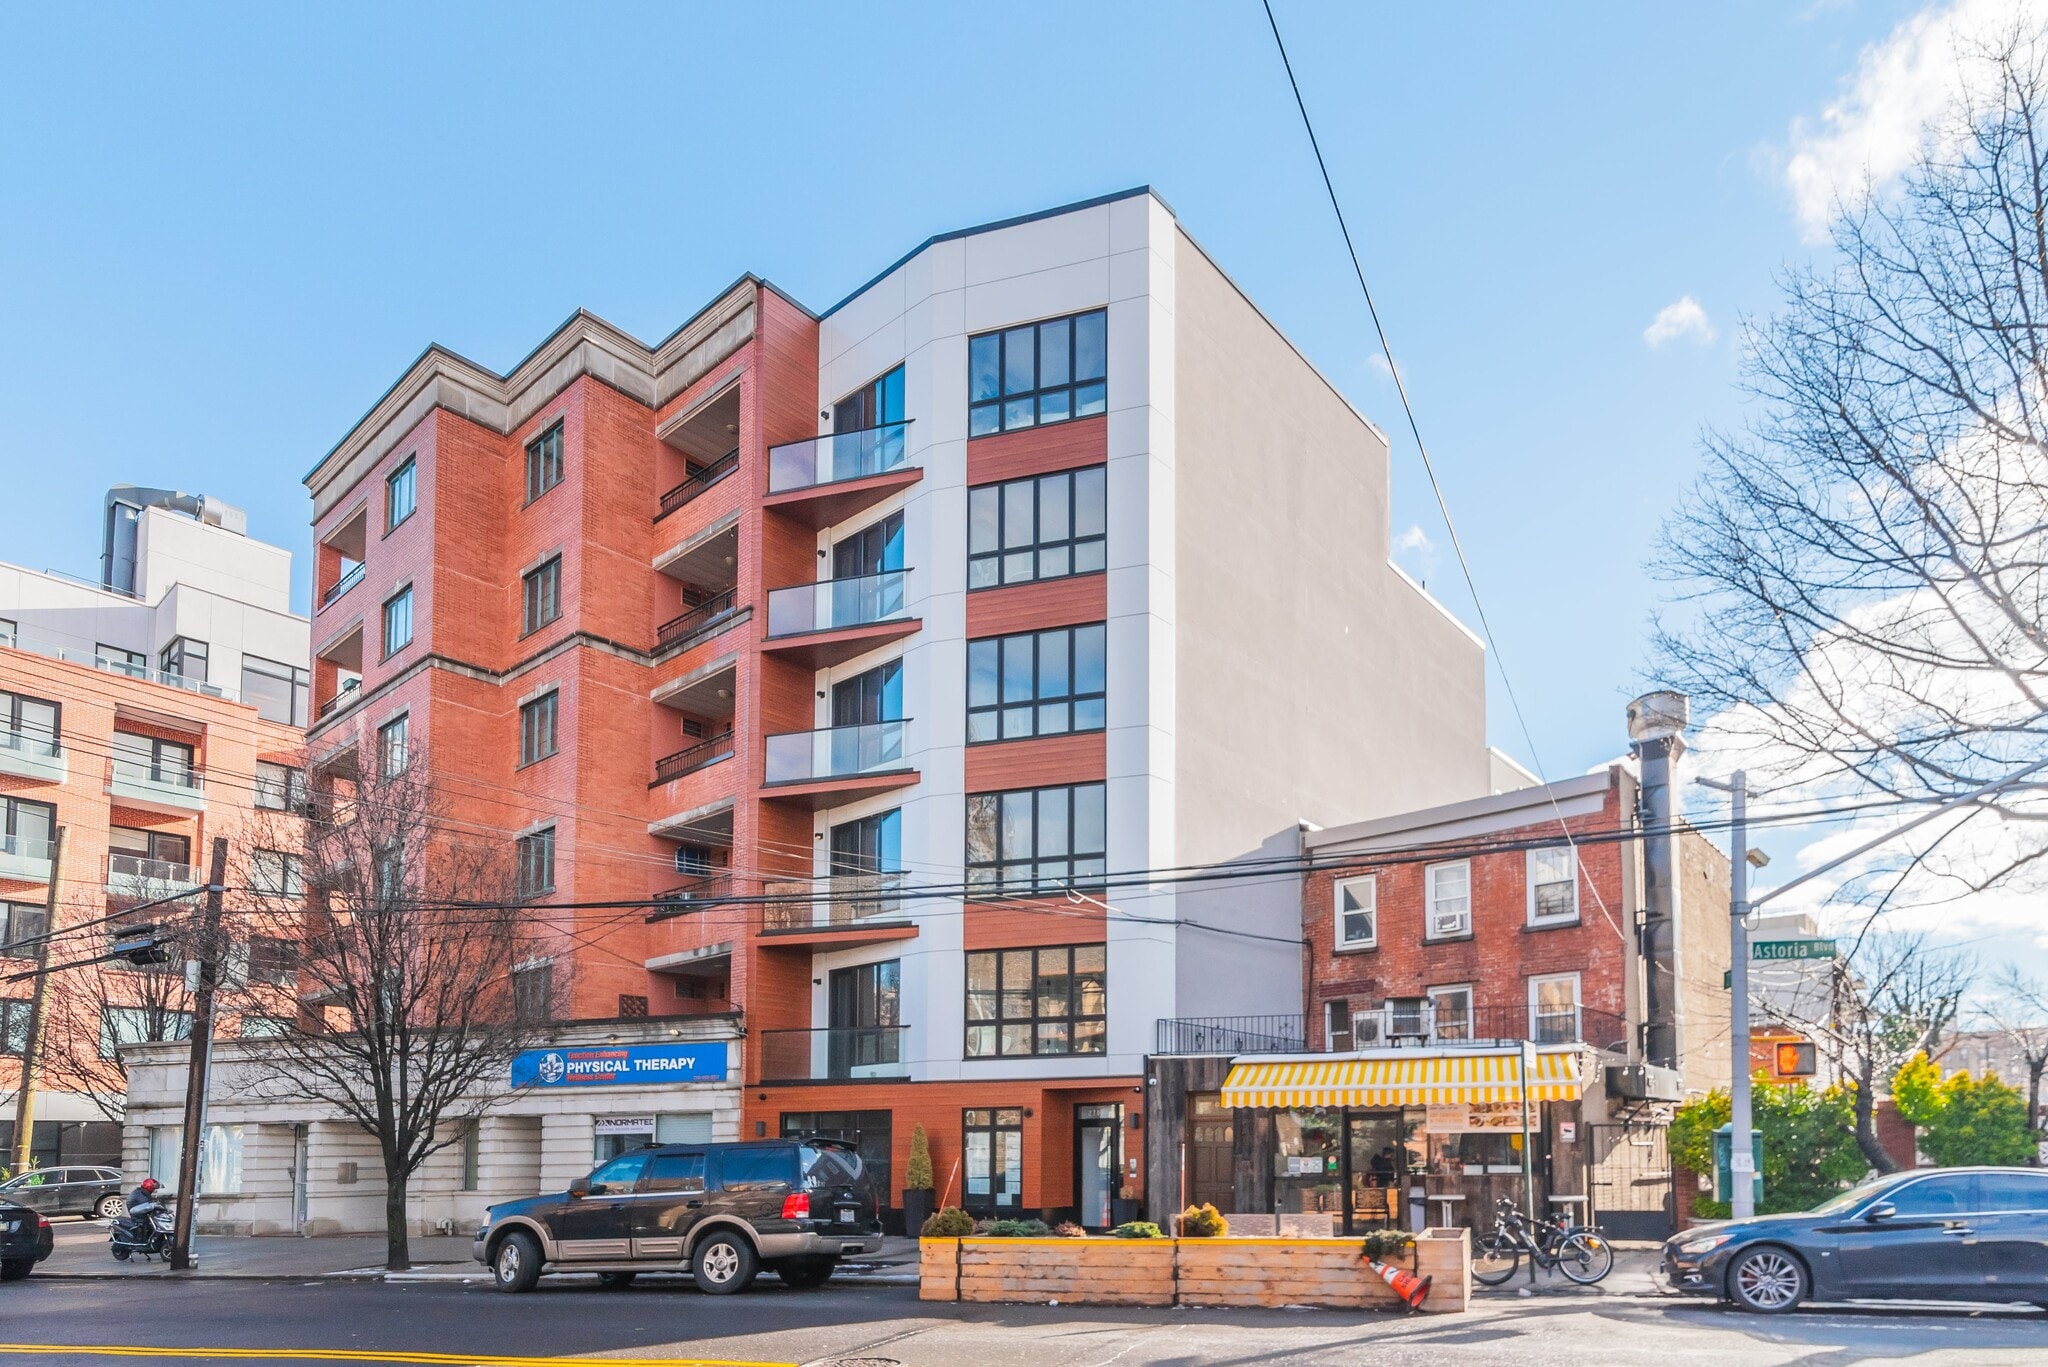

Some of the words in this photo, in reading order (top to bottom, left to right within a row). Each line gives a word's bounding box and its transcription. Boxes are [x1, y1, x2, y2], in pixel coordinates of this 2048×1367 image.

[1754, 943, 1807, 958] Astoria
[1813, 942, 1834, 952] Blvd
[566, 1060, 630, 1074] PHYSICAL
[634, 1058, 696, 1071] THERAPY
